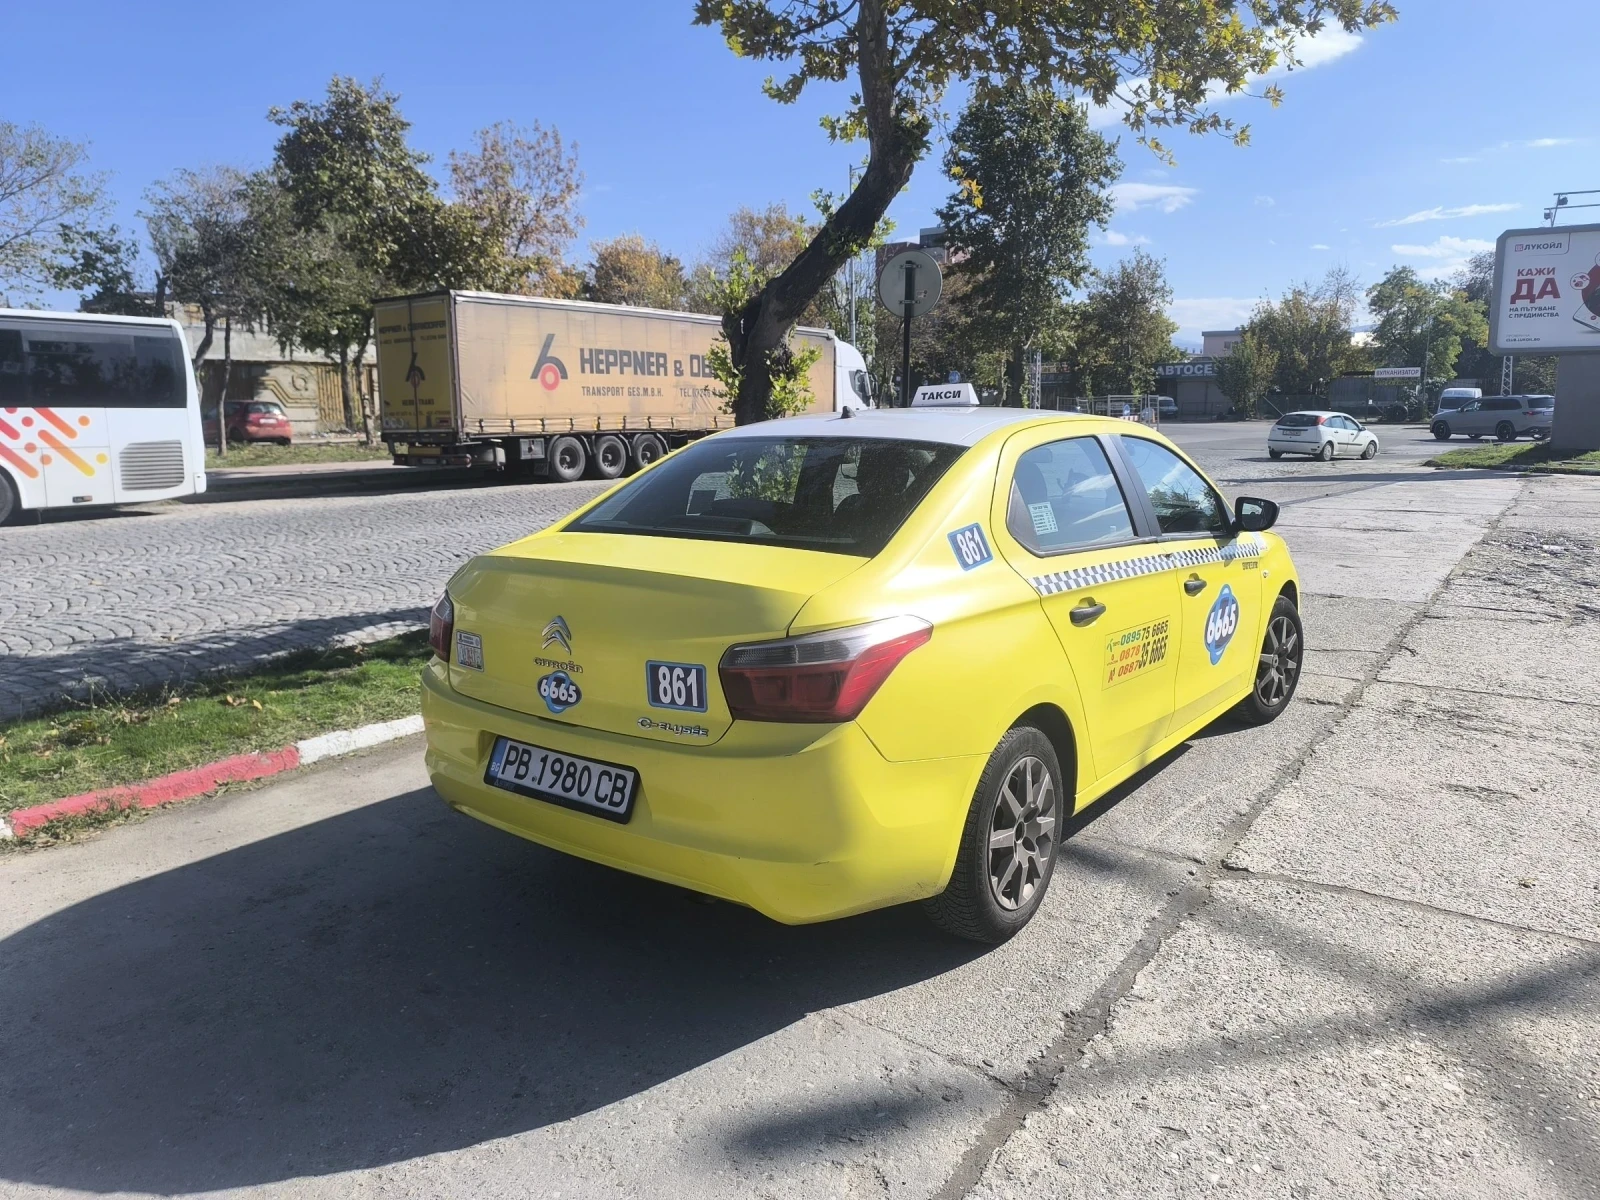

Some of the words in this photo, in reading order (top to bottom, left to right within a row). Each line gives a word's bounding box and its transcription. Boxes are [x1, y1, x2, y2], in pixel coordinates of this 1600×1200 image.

[1524, 242, 1562, 250] ЛУКОЙЛ
[1517, 267, 1556, 276] КАЖИ
[1510, 278, 1561, 304] ДА
[580, 348, 668, 377] HEPPNER
[674, 360, 684, 377] &
[690, 354, 714, 378] OB
[1157, 364, 1213, 376] АВТОСЕ
[582, 386, 624, 397] TRANSPORT
[628, 387, 664, 397] GES.M.B.H.
[921, 390, 961, 400] ТАКСИ
[957, 527, 987, 565] 861
[1207, 604, 1236, 644] 6665
[1120, 629, 1142, 646] 0895
[540, 679, 577, 703] 6665
[658, 665, 698, 707] 861
[490, 762, 500, 772] BG
[537, 754, 592, 797] 1980
[594, 770, 628, 808] CB
